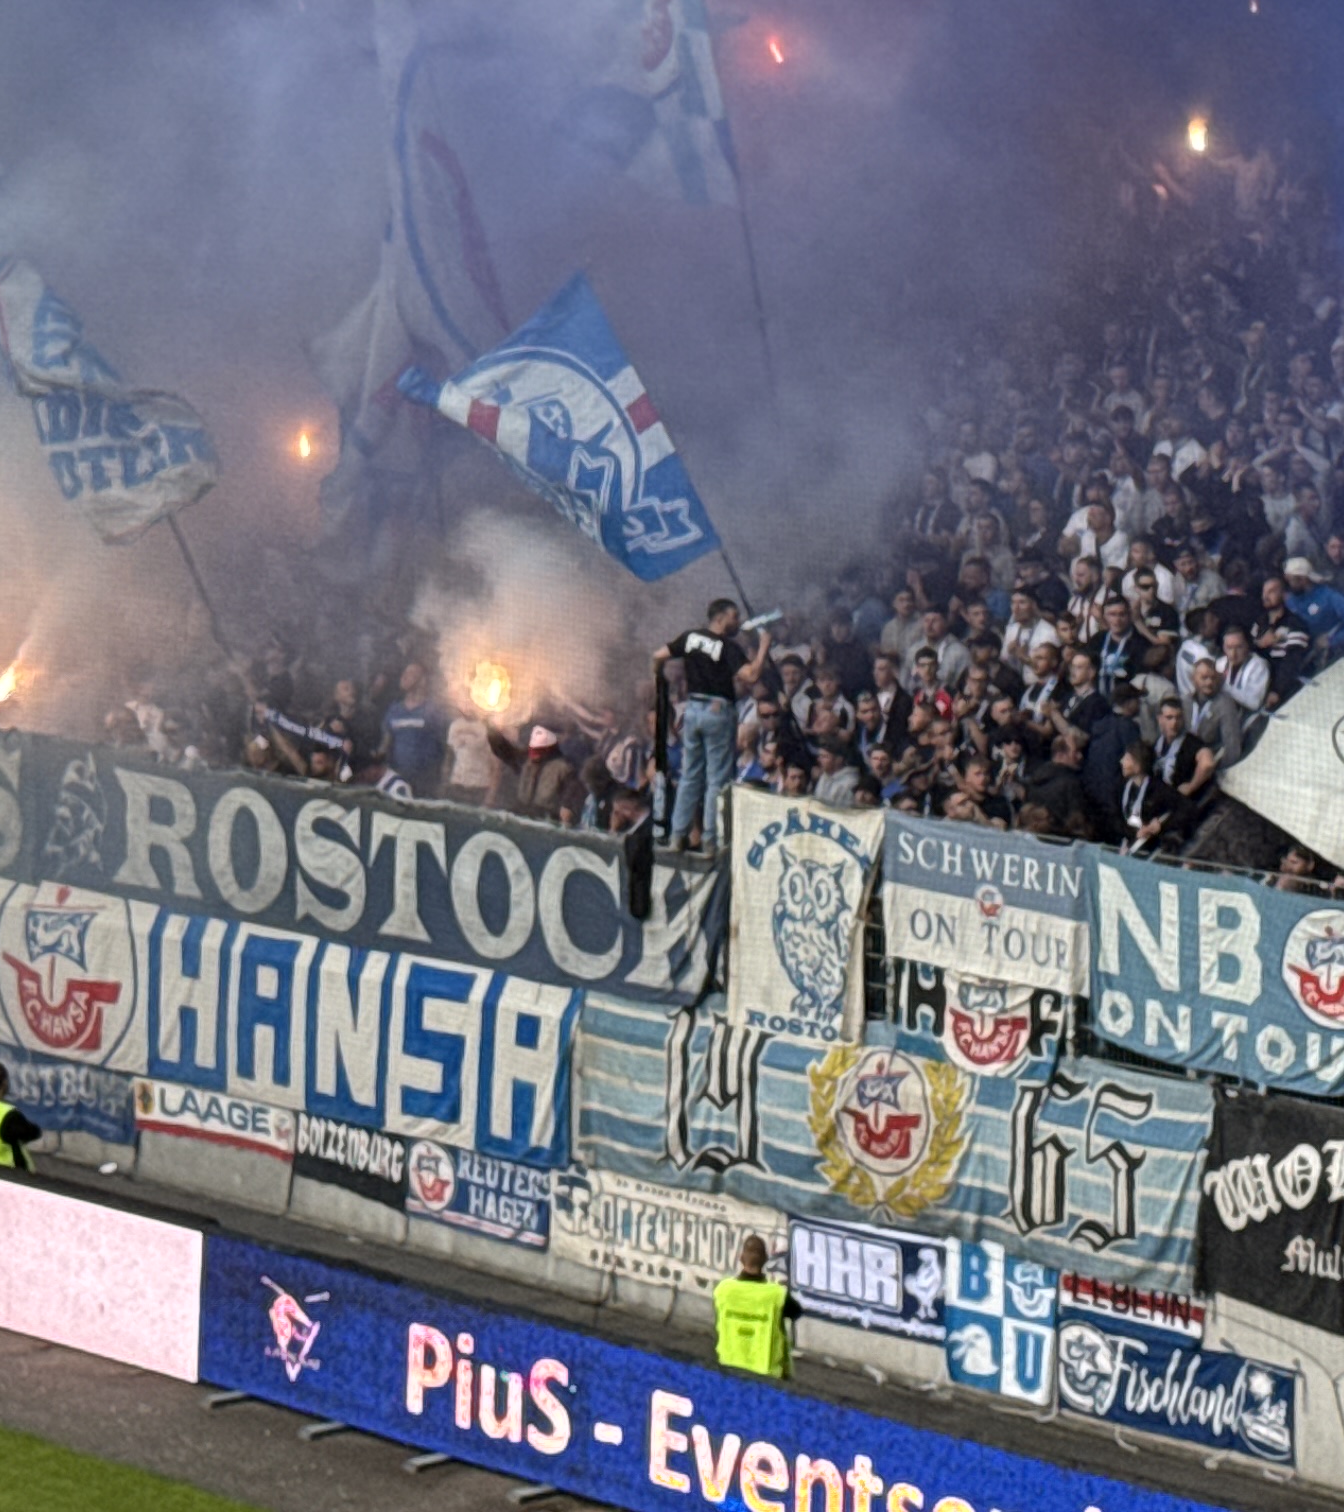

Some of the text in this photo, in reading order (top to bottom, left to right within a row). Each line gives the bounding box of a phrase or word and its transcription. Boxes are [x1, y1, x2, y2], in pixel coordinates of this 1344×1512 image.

[897, 831, 1084, 899] SCHWERIN
[910, 908, 956, 946] ON
[1097, 861, 1263, 1007] NB
[158, 913, 577, 1150] HANSA
[745, 1008, 839, 1044] ROSTO
[1098, 989, 1192, 1053] ON
[158, 1086, 271, 1135] LAAGE
[467, 1184, 540, 1231] HAGEN
[792, 1226, 900, 1308] HHR
[406, 1324, 571, 1458] PiuS
[1094, 1333, 1249, 1437] Fischland
